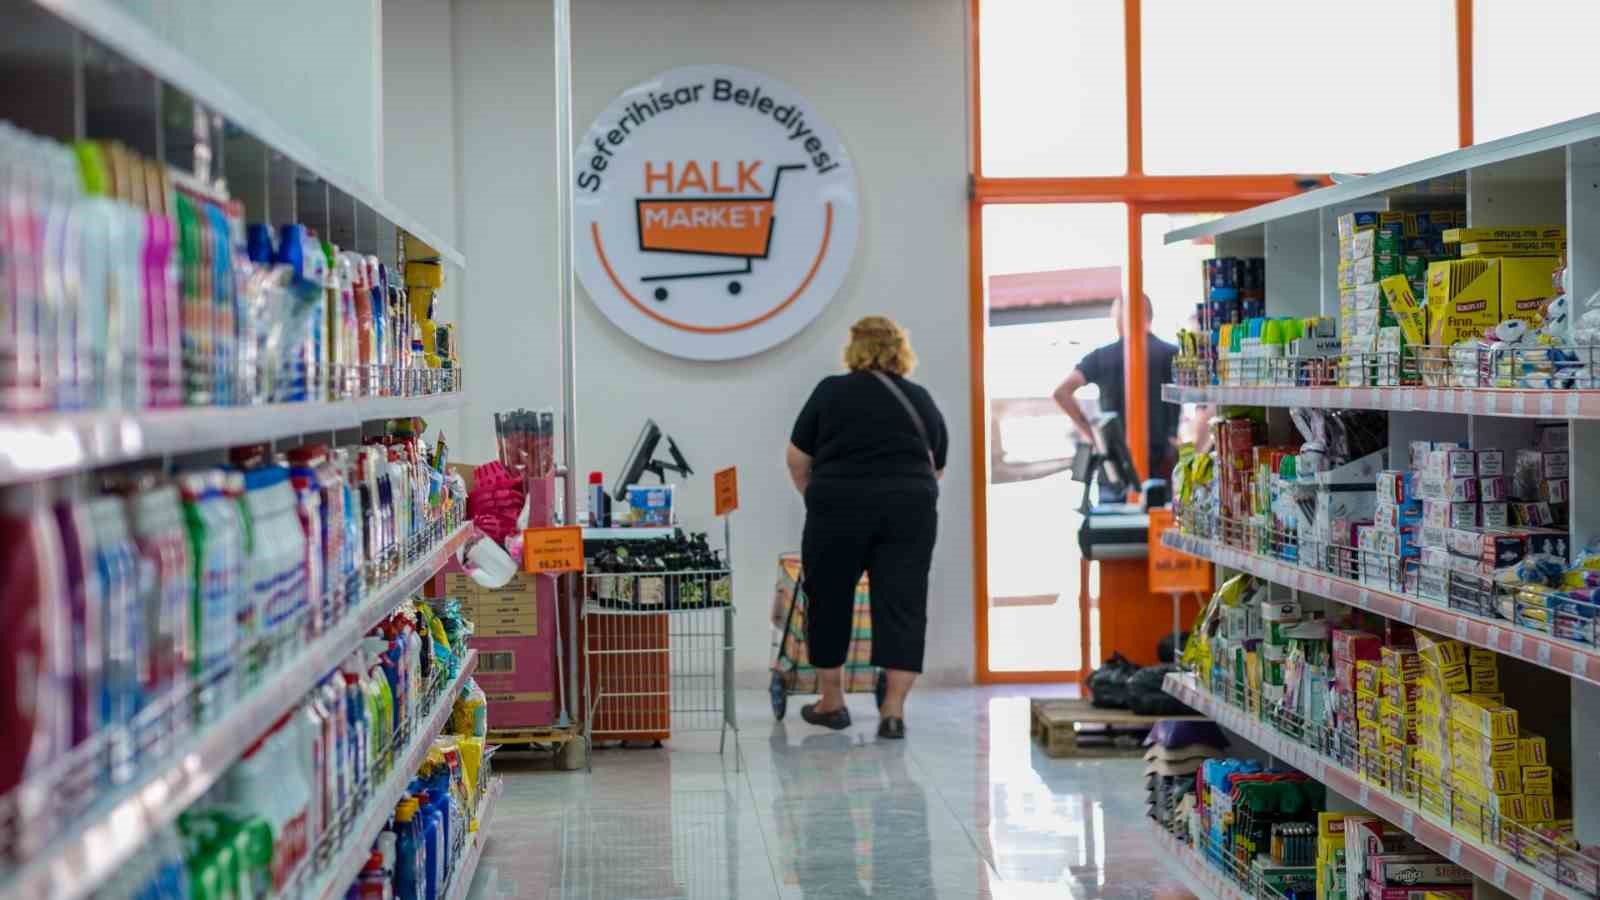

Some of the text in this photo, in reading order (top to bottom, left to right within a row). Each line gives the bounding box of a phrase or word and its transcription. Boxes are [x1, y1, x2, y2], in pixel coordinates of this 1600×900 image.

[577, 78, 839, 192] Seferihisar Belediyesi
[644, 160, 765, 193] HALK
[644, 206, 766, 229] MARKET
